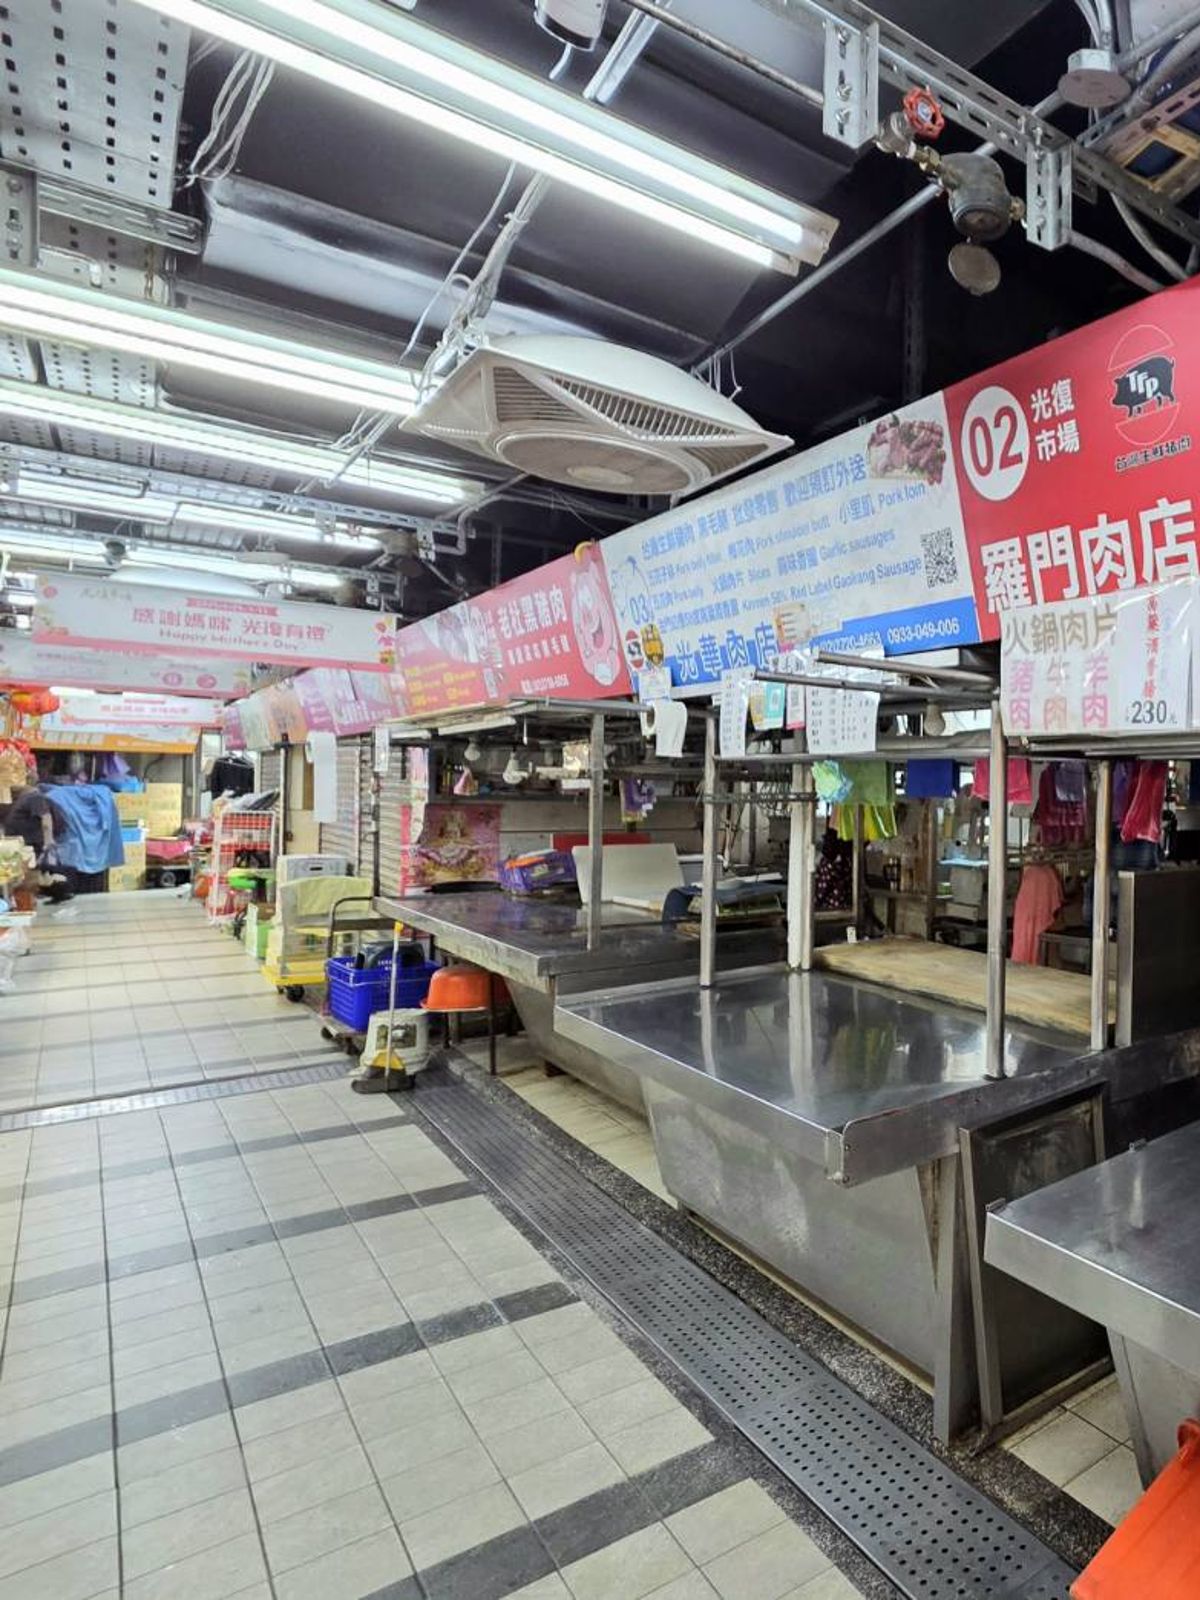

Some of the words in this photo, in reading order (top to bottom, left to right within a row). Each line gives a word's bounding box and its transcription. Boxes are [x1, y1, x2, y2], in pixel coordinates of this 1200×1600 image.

[1031, 378, 1075, 424] 光復
[969, 405, 1023, 477] 02
[1035, 420, 1080, 462] 市場
[980, 498, 1200, 615] 羅門肉店
[1004, 602, 1119, 657] 火鍋肉片
